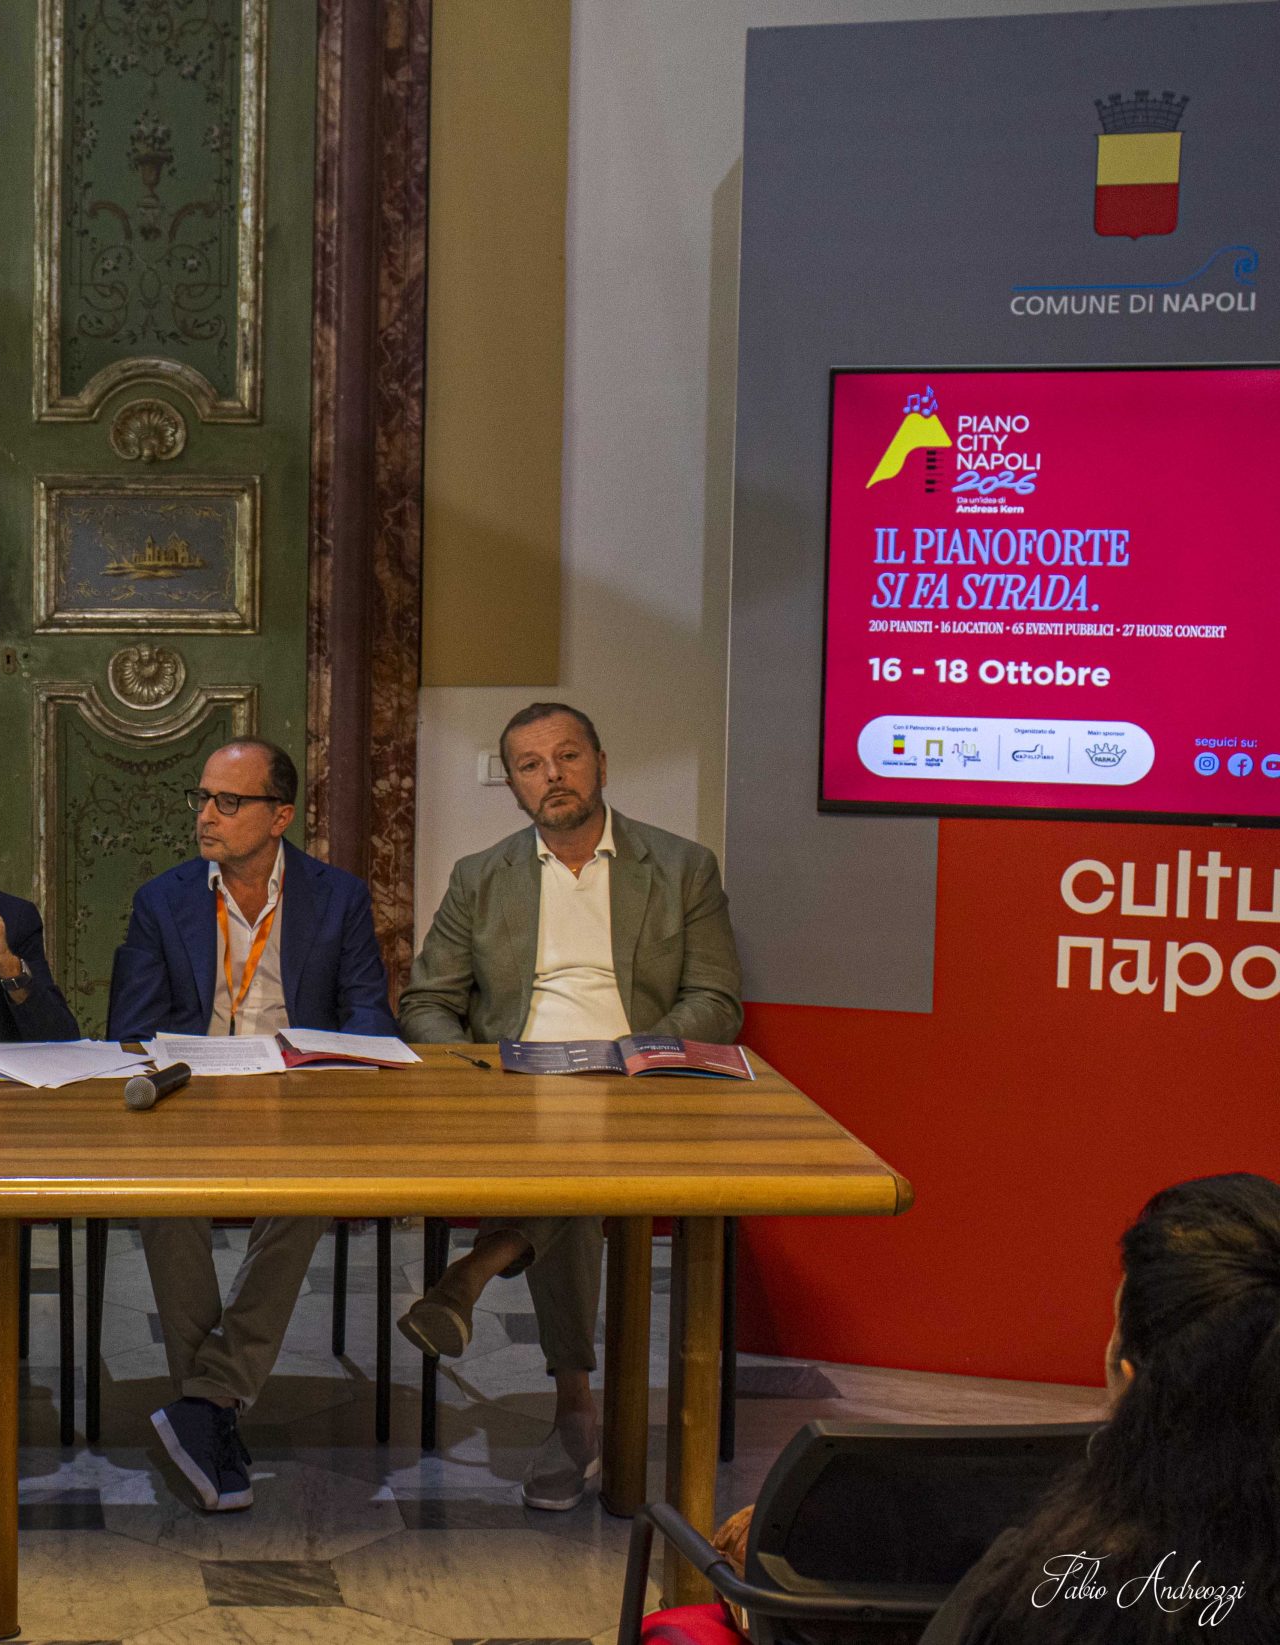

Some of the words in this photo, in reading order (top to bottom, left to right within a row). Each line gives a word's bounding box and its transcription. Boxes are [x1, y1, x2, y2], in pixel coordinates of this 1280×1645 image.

[1010, 295, 1120, 316] COMUNE
[1129, 294, 1154, 313] DI
[1162, 292, 1257, 312] NAPOLI
[957, 415, 1030, 433] PIANO
[956, 434, 1008, 452] CITY
[956, 452, 1041, 471] NAPOLI
[951, 470, 1038, 495] 2026
[956, 504, 998, 514] Andreas
[1000, 504, 1025, 514] Kern
[998, 496, 1006, 504] di
[873, 528, 906, 565] IL
[912, 528, 1130, 567] PIANOFORTE
[871, 572, 909, 608] SI
[908, 573, 950, 609] FA
[956, 574, 1100, 612] STRADA.
[868, 620, 888, 632] 200
[889, 620, 933, 633] PIANISTI
[940, 621, 951, 633] 16
[952, 621, 1004, 634] LOCATION
[1011, 622, 1024, 634] 65
[1025, 622, 1063, 635] EVENTI
[1065, 623, 1114, 636] PUBBLICI
[1122, 624, 1135, 636] 27
[1136, 624, 1173, 637] HOUSE
[1174, 625, 1227, 638] CONCERT
[868, 657, 902, 682] 16
[935, 659, 968, 683] 18
[978, 660, 1111, 686] Ottobre
[1195, 736, 1238, 748] seguici
[1240, 739, 1258, 748] su:
[1060, 849, 1280, 923] cultu
[1056, 935, 1280, 1013] napo
